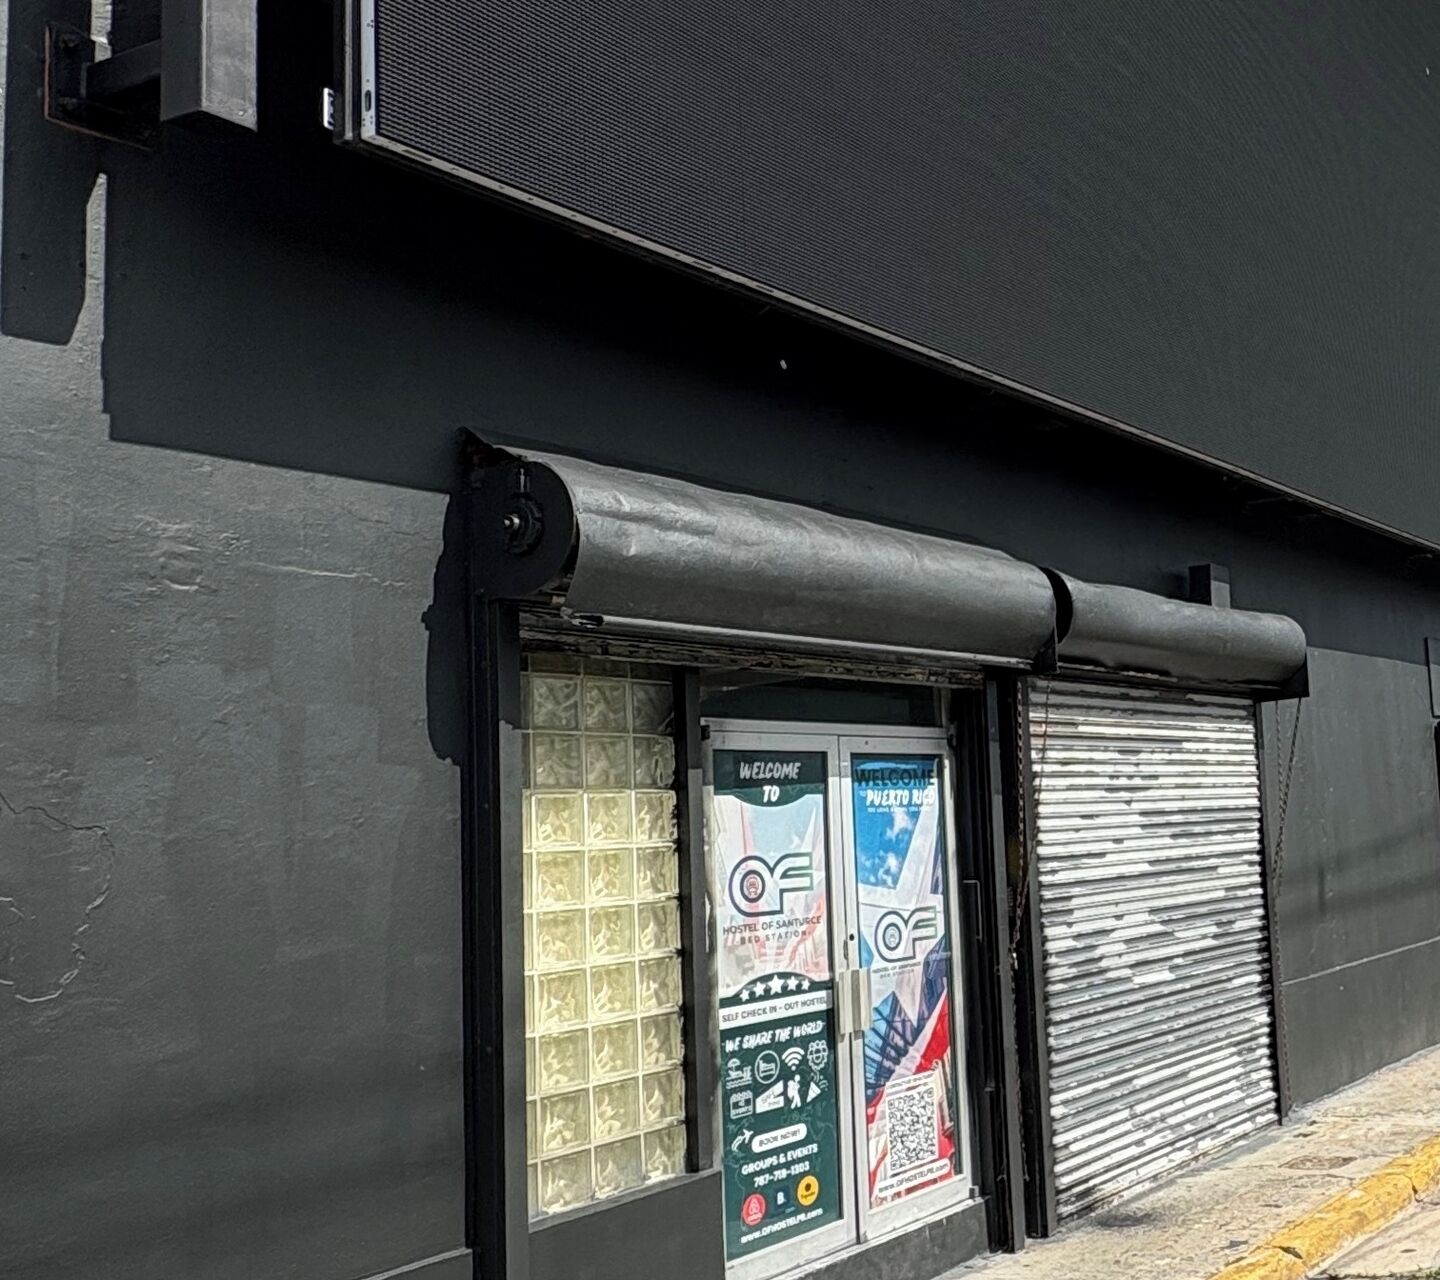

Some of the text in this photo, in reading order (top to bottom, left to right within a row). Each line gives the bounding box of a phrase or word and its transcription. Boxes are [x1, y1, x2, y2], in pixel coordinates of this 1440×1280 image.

[740, 761, 801, 780] WELCOME
[855, 768, 935, 786] WELCOME
[762, 785, 780, 803] TO
[866, 789, 909, 807] PUERTO
[911, 788, 936, 805] RICO
[722, 915, 823, 936] HOSTEL OF SANTURCE
[721, 1012, 740, 1023] SELF
[741, 1008, 768, 1019] CHECK
[769, 1005, 778, 1014] IN
[783, 1001, 799, 1012] OUT
[800, 996, 828, 1007] HOSTEL
[725, 1020, 823, 1053] WE SHARE THE WORLD
[741, 1143, 818, 1175] GROUPS & EVENTS
